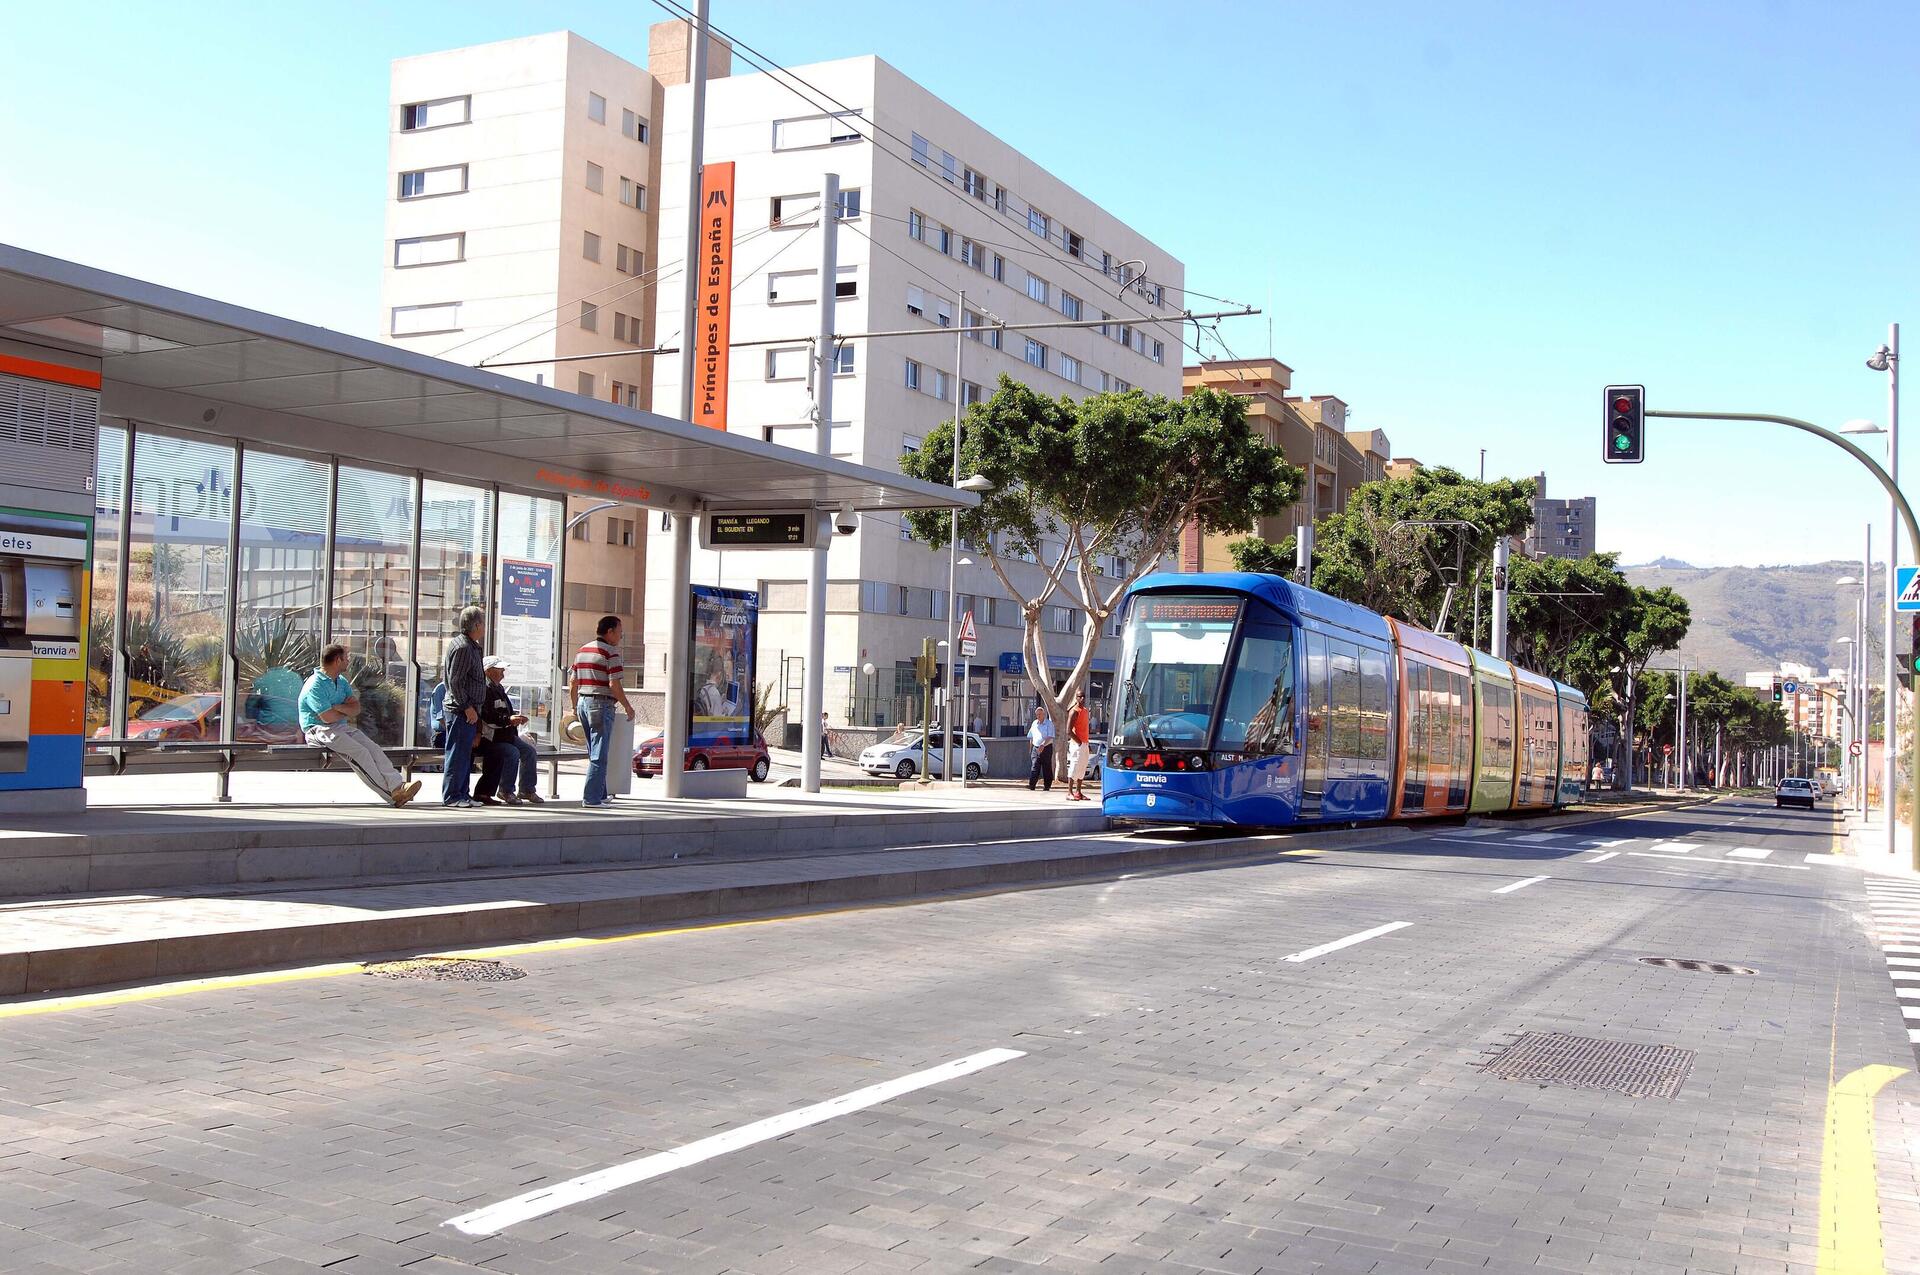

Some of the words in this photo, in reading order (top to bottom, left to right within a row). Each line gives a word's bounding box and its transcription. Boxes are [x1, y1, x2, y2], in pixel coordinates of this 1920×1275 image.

[708, 217, 724, 286] España
[706, 293, 719, 317] de
[703, 322, 720, 415] Príncipes
[746, 517, 770, 525] LLEGANDO
[720, 611, 747, 627] juntos
[1114, 735, 1125, 746] 01
